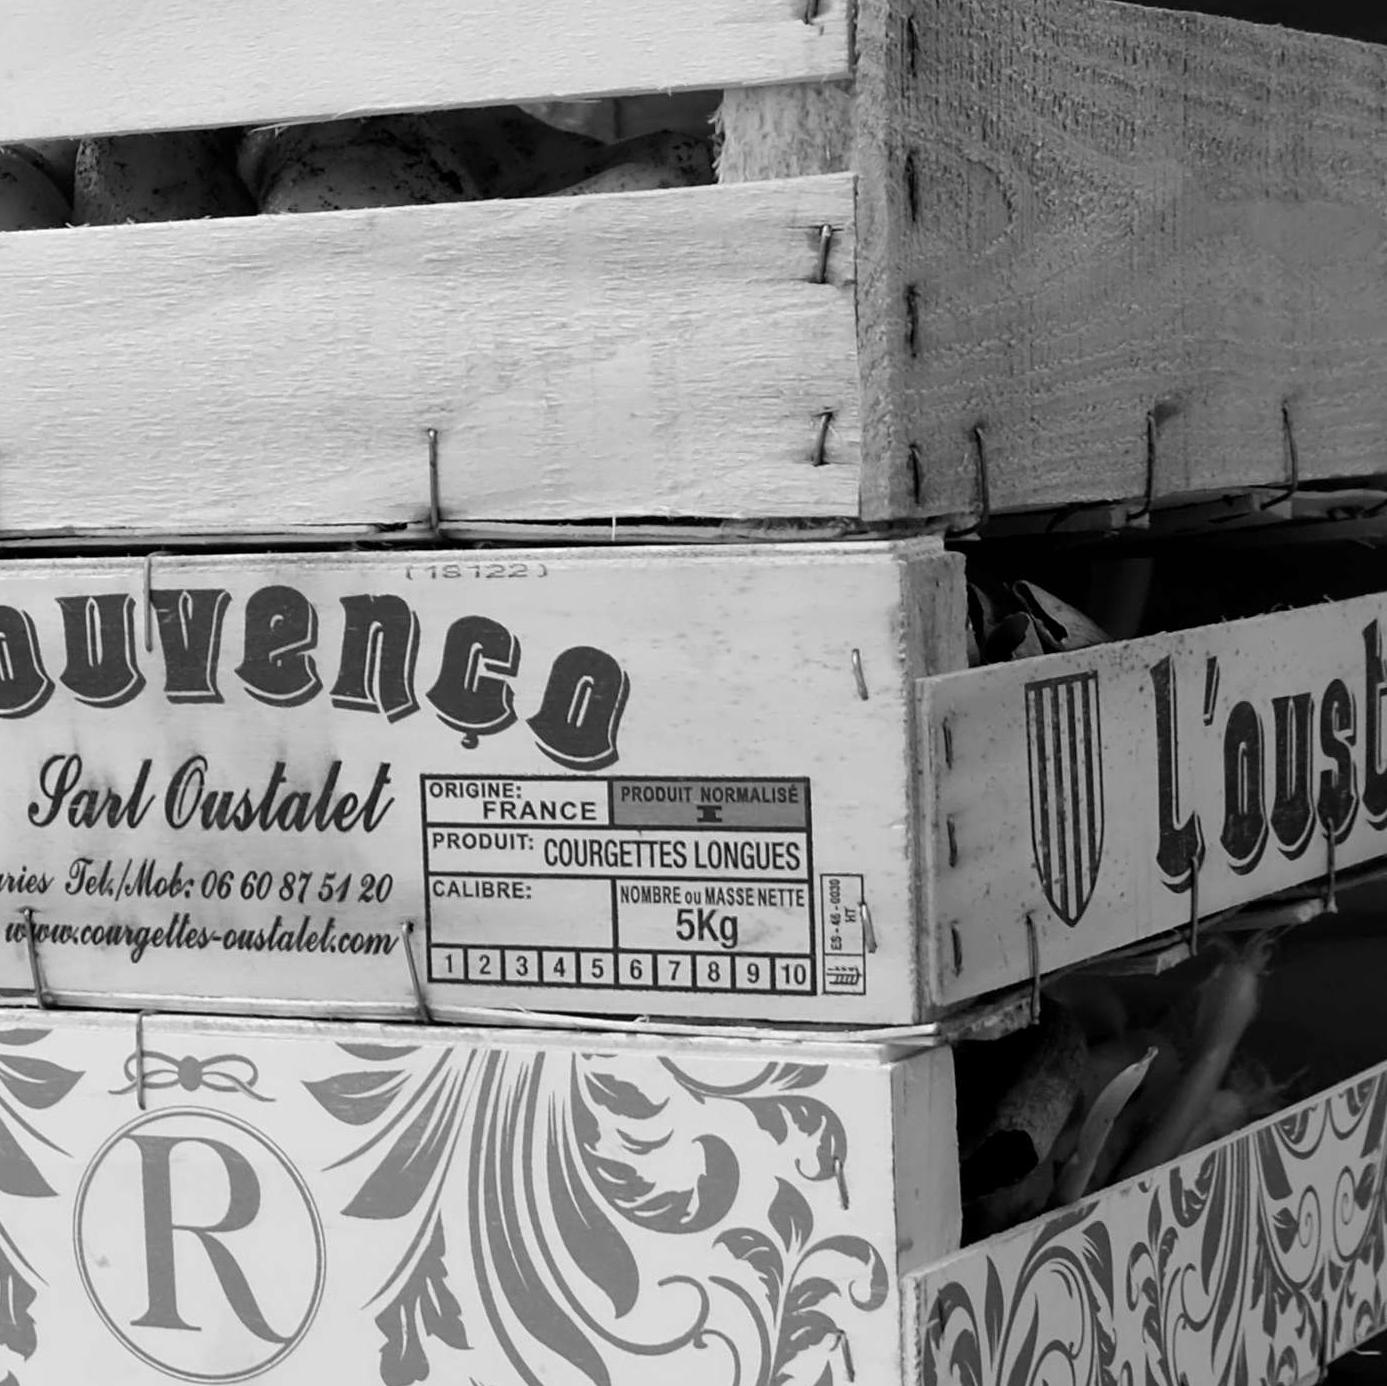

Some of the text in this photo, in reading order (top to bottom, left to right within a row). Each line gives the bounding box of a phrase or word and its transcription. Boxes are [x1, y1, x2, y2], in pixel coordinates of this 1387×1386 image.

[28, 754, 396, 834] Sarl Oustalet
[429, 781, 523, 801] ORIGINE:
[621, 784, 800, 805] PRODUIT NORMALISÉ
[482, 800, 597, 822] FRANCE
[432, 832, 535, 852] PRODUIT:
[543, 837, 802, 871] COURGETTES LONGUES
[201, 871, 233, 902] 06
[239, 871, 271, 902] 60
[277, 871, 312, 904] 87
[317, 871, 351, 904] 51
[356, 872, 395, 905] 20
[432, 879, 532, 900] CALIBRE:
[620, 885, 806, 908] NOMBRE ou MASSE NETTE
[675, 908, 740, 948] 5Kg
[444, 954, 807, 986] 1 2 3 4 5 6 7 8 9 10
[122, 1133, 290, 1345] R
